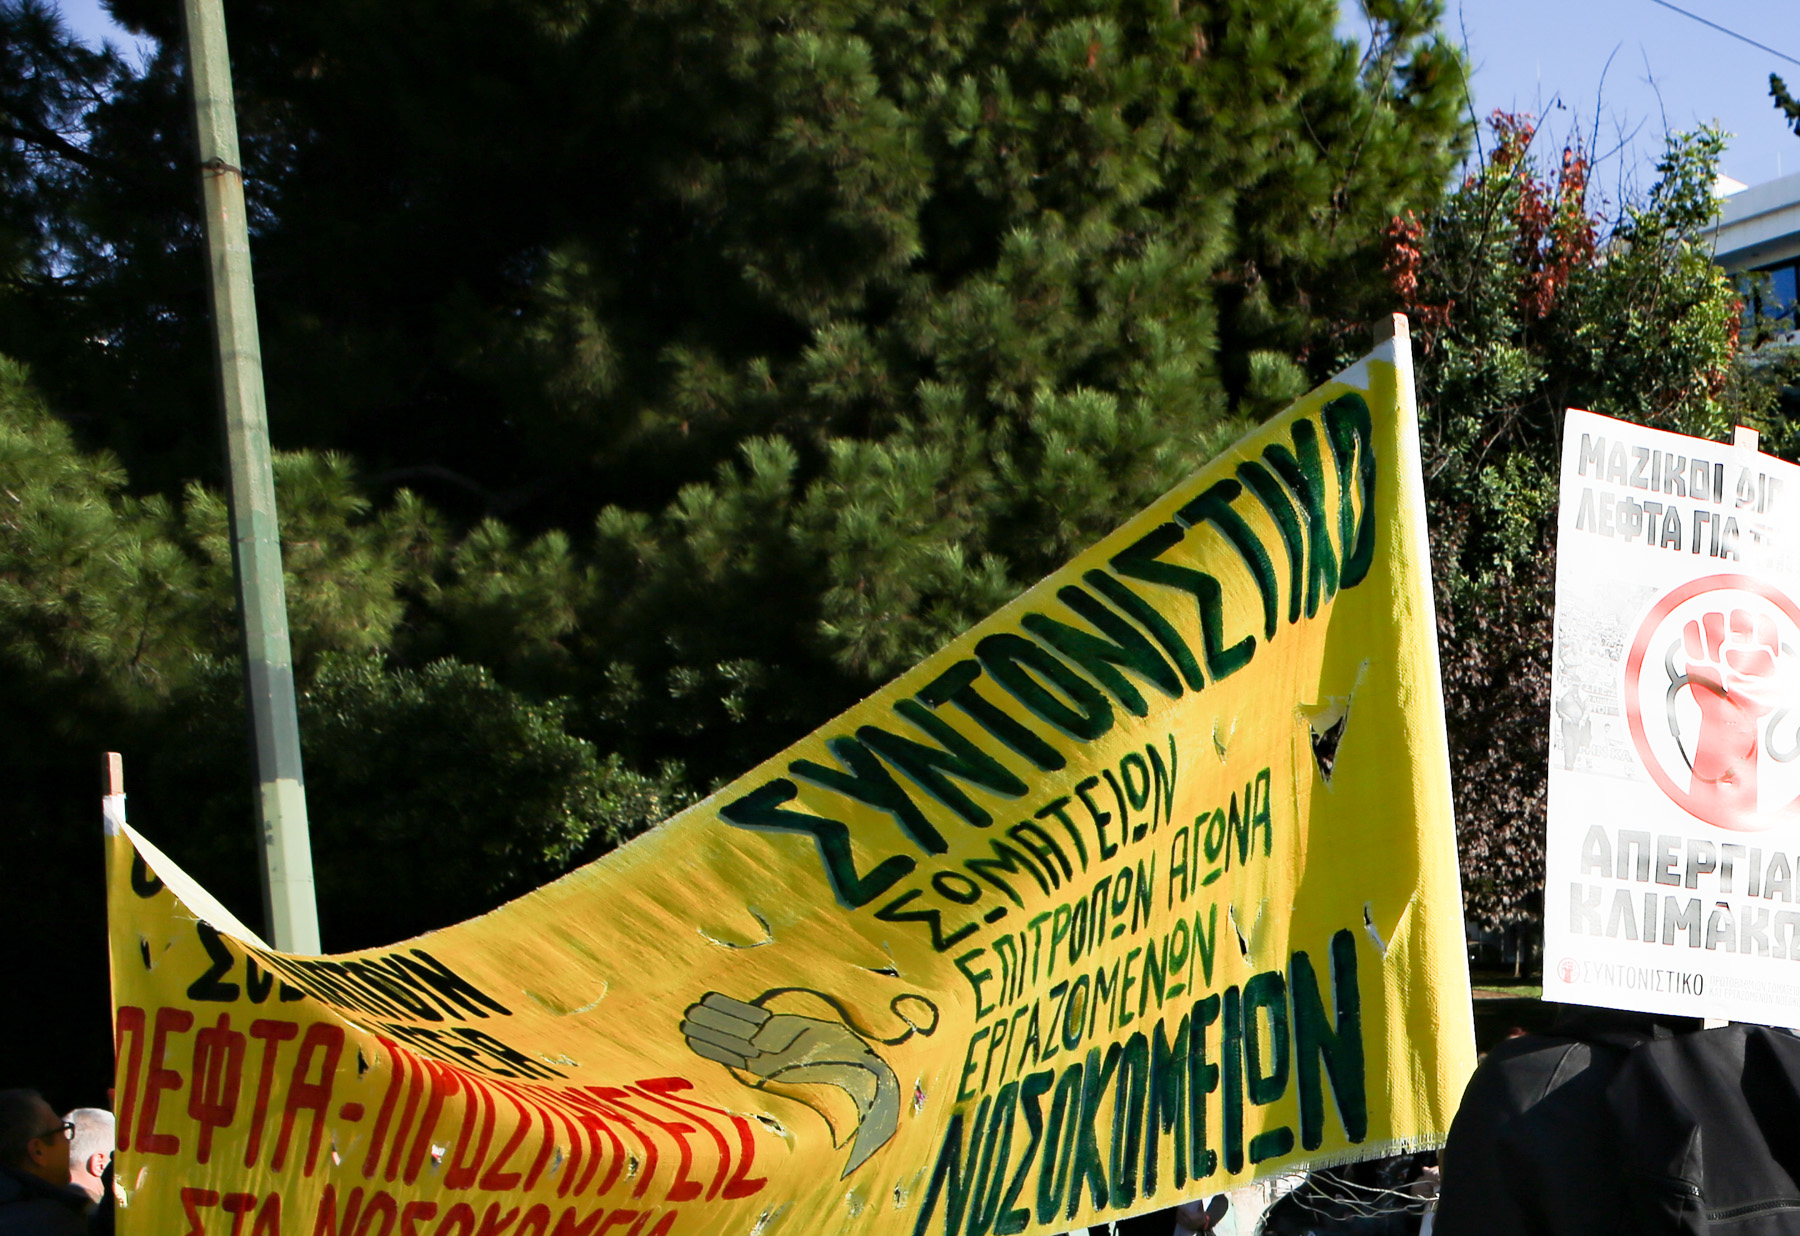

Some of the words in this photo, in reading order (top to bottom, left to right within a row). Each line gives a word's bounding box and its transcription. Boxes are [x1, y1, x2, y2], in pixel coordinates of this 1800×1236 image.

[1575, 487, 1682, 551] ΛΕΦΤΑ
[1692, 509, 1740, 562] ΓΙΑ
[1577, 433, 1724, 504] ΜΑΖΙΚΟΙ
[719, 391, 1376, 908] ΣΥΝΤΟΝΙΣΤΙΚΟ
[875, 734, 1178, 952] ΣΩΜΑΤΕΙΩΝ
[953, 851, 1155, 1021] ΕΠΙΤΡΟΠΩΝ
[1168, 766, 1275, 912] ΑΓΩΝΑ
[957, 901, 1219, 1103] ΕΡΓΑΖΟΜΕΝΩΝ
[1583, 960, 1704, 996] ΣΥΝΤΟΝΙΣΤΙΚΟ
